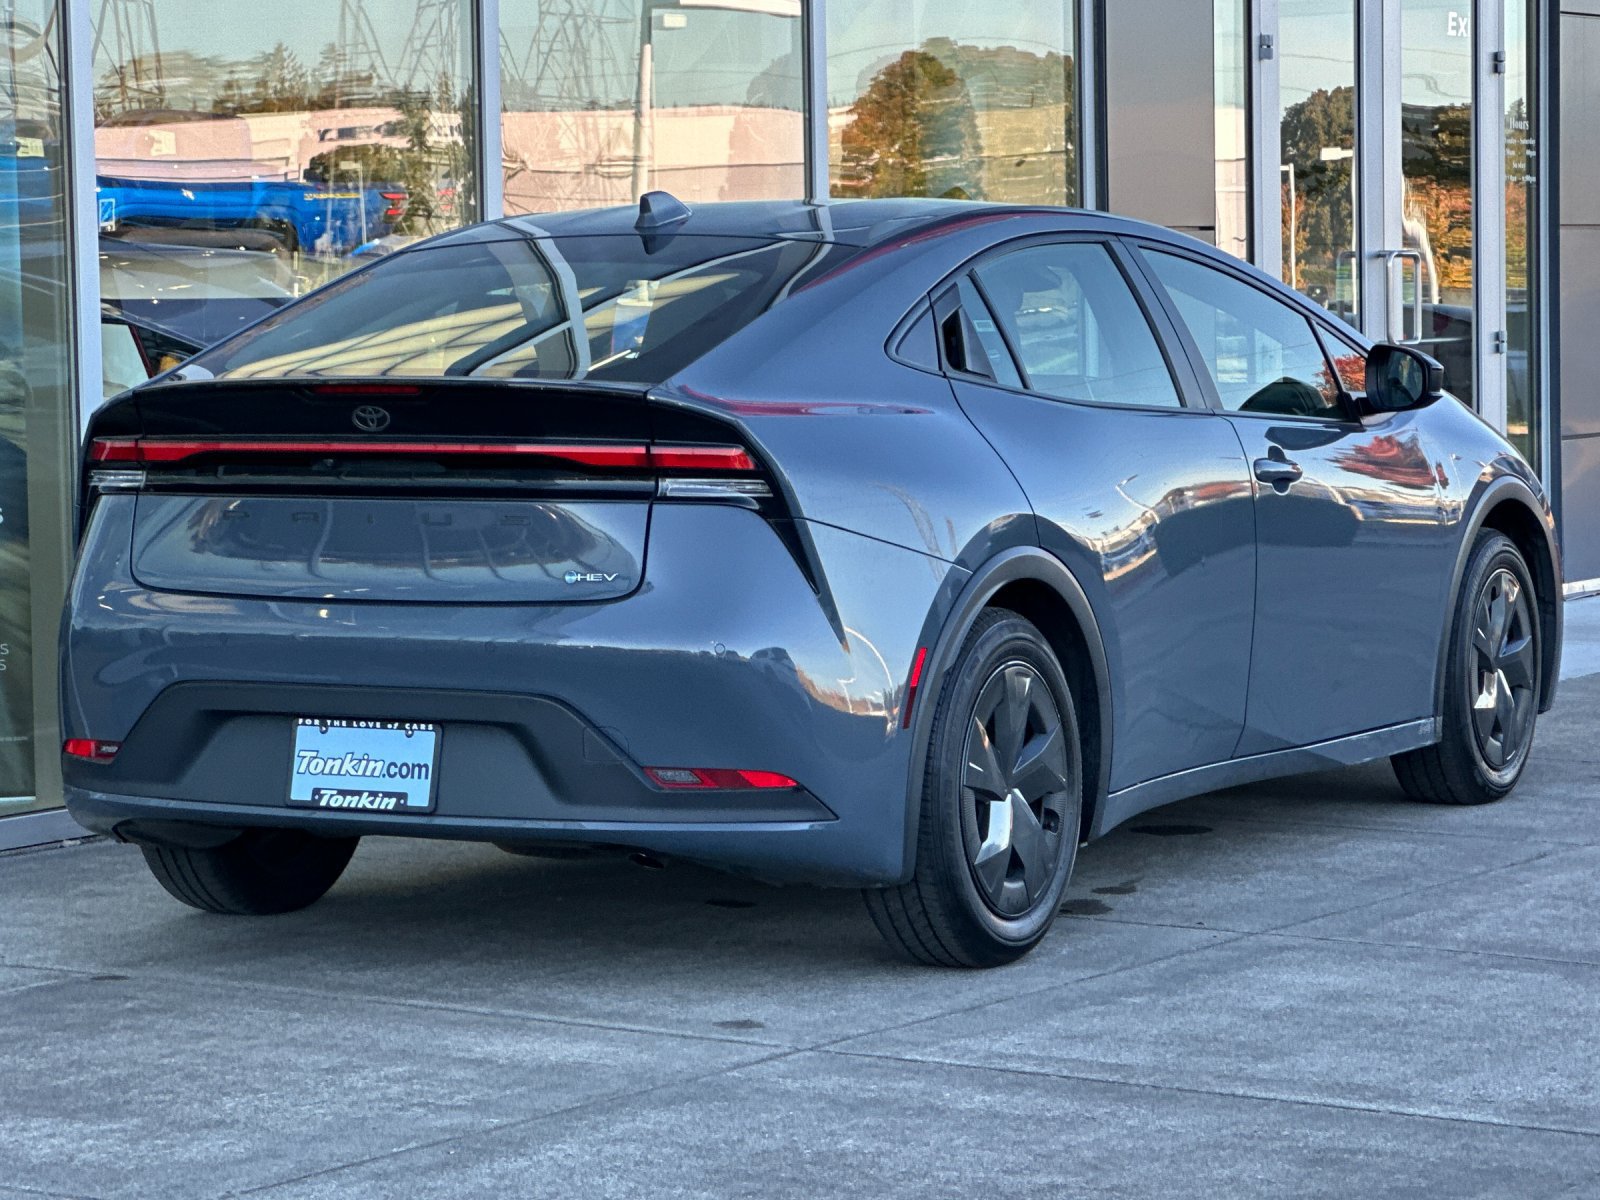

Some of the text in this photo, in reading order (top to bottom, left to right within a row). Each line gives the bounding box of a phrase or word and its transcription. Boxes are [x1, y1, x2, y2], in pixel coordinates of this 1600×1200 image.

[1509, 117, 1529, 130] Hours
[577, 572, 618, 582] HEV
[298, 718, 320, 726] FOR
[352, 721, 381, 729] LOVE
[405, 723, 434, 731] CARS
[297, 750, 430, 780] Tonkin.com
[319, 790, 397, 810] Tonkin
